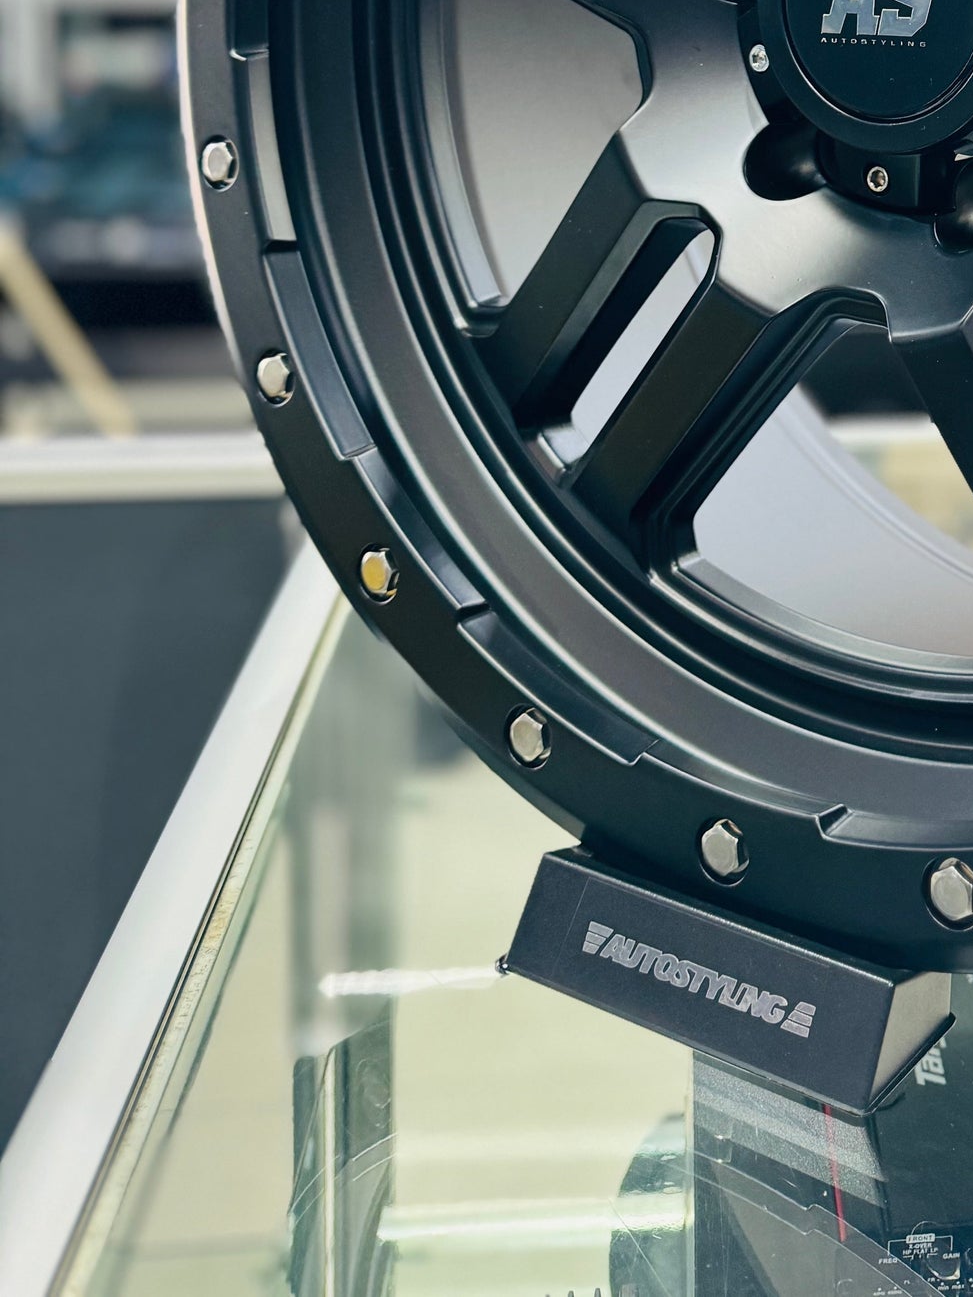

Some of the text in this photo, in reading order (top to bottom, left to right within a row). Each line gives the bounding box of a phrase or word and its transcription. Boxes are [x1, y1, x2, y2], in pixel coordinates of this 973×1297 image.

[820, 37, 927, 47] AUTOSTYLING
[599, 933, 788, 1025] AUTOSTYLING
[907, 1233, 934, 1242] FRONT
[942, 1252, 961, 1260] GAIN
[878, 1257, 898, 1265] FREQ
